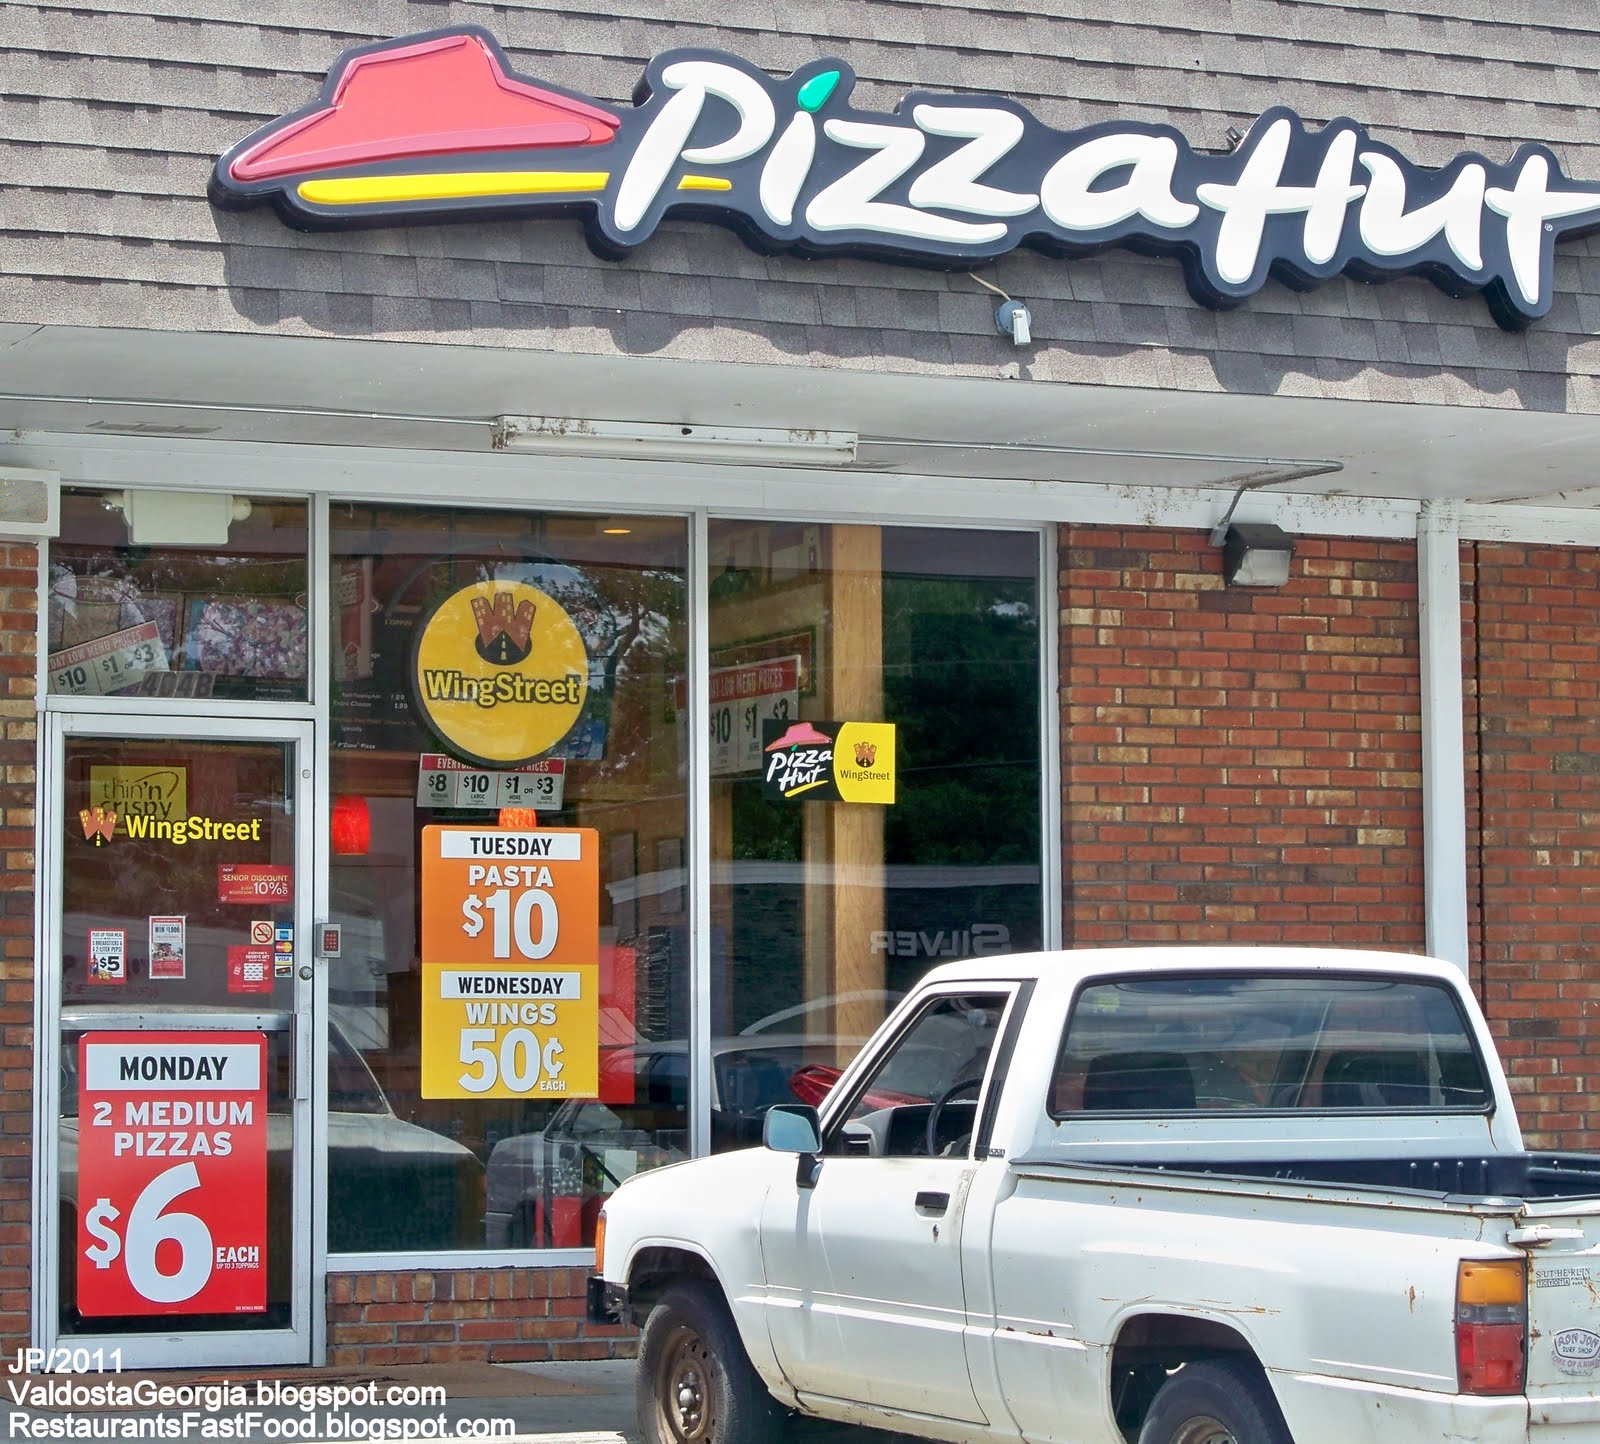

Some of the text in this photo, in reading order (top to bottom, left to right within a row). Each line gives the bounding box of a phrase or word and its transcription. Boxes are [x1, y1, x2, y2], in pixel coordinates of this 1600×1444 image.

[614, 60, 1600, 304] Pizza Hut
[68, 648, 86, 663] LOW
[87, 640, 111, 657] MENU
[112, 630, 143, 648] PRICES
[58, 666, 87, 689] $10
[102, 656, 119, 674] $1
[759, 666, 783, 691] PRICES
[425, 670, 581, 708] WingStreet
[745, 703, 757, 739] $1
[766, 744, 834, 783] Pizza
[840, 769, 891, 782] WingStreet
[428, 773, 448, 792] $8
[463, 774, 490, 793] $10
[505, 775, 520, 794] $1
[536, 776, 554, 795] $3
[778, 767, 827, 792] Hut
[125, 814, 262, 845] WingStreet
[470, 836, 553, 857] TUESDAY
[222, 874, 289, 882] SENIOR DISCOUNT
[253, 881, 283, 895] 10%
[468, 865, 555, 888] PASTA
[462, 888, 560, 960] $10
[99, 955, 121, 972] $5
[458, 976, 565, 995] WEDNESDAY
[465, 1002, 558, 1026] WINGS
[119, 1056, 228, 1081] MONDAY
[457, 1027, 565, 1094] 50¢
[540, 1080, 566, 1091] EACH
[92, 1101, 253, 1127] 2 MEDIUM
[114, 1131, 233, 1157] PIZZAS
[84, 1160, 214, 1304] $6
[216, 1246, 259, 1263] EACH
[1558, 1333, 1600, 1348] RON JON
[1578, 1347, 1593, 1355] SHOP
